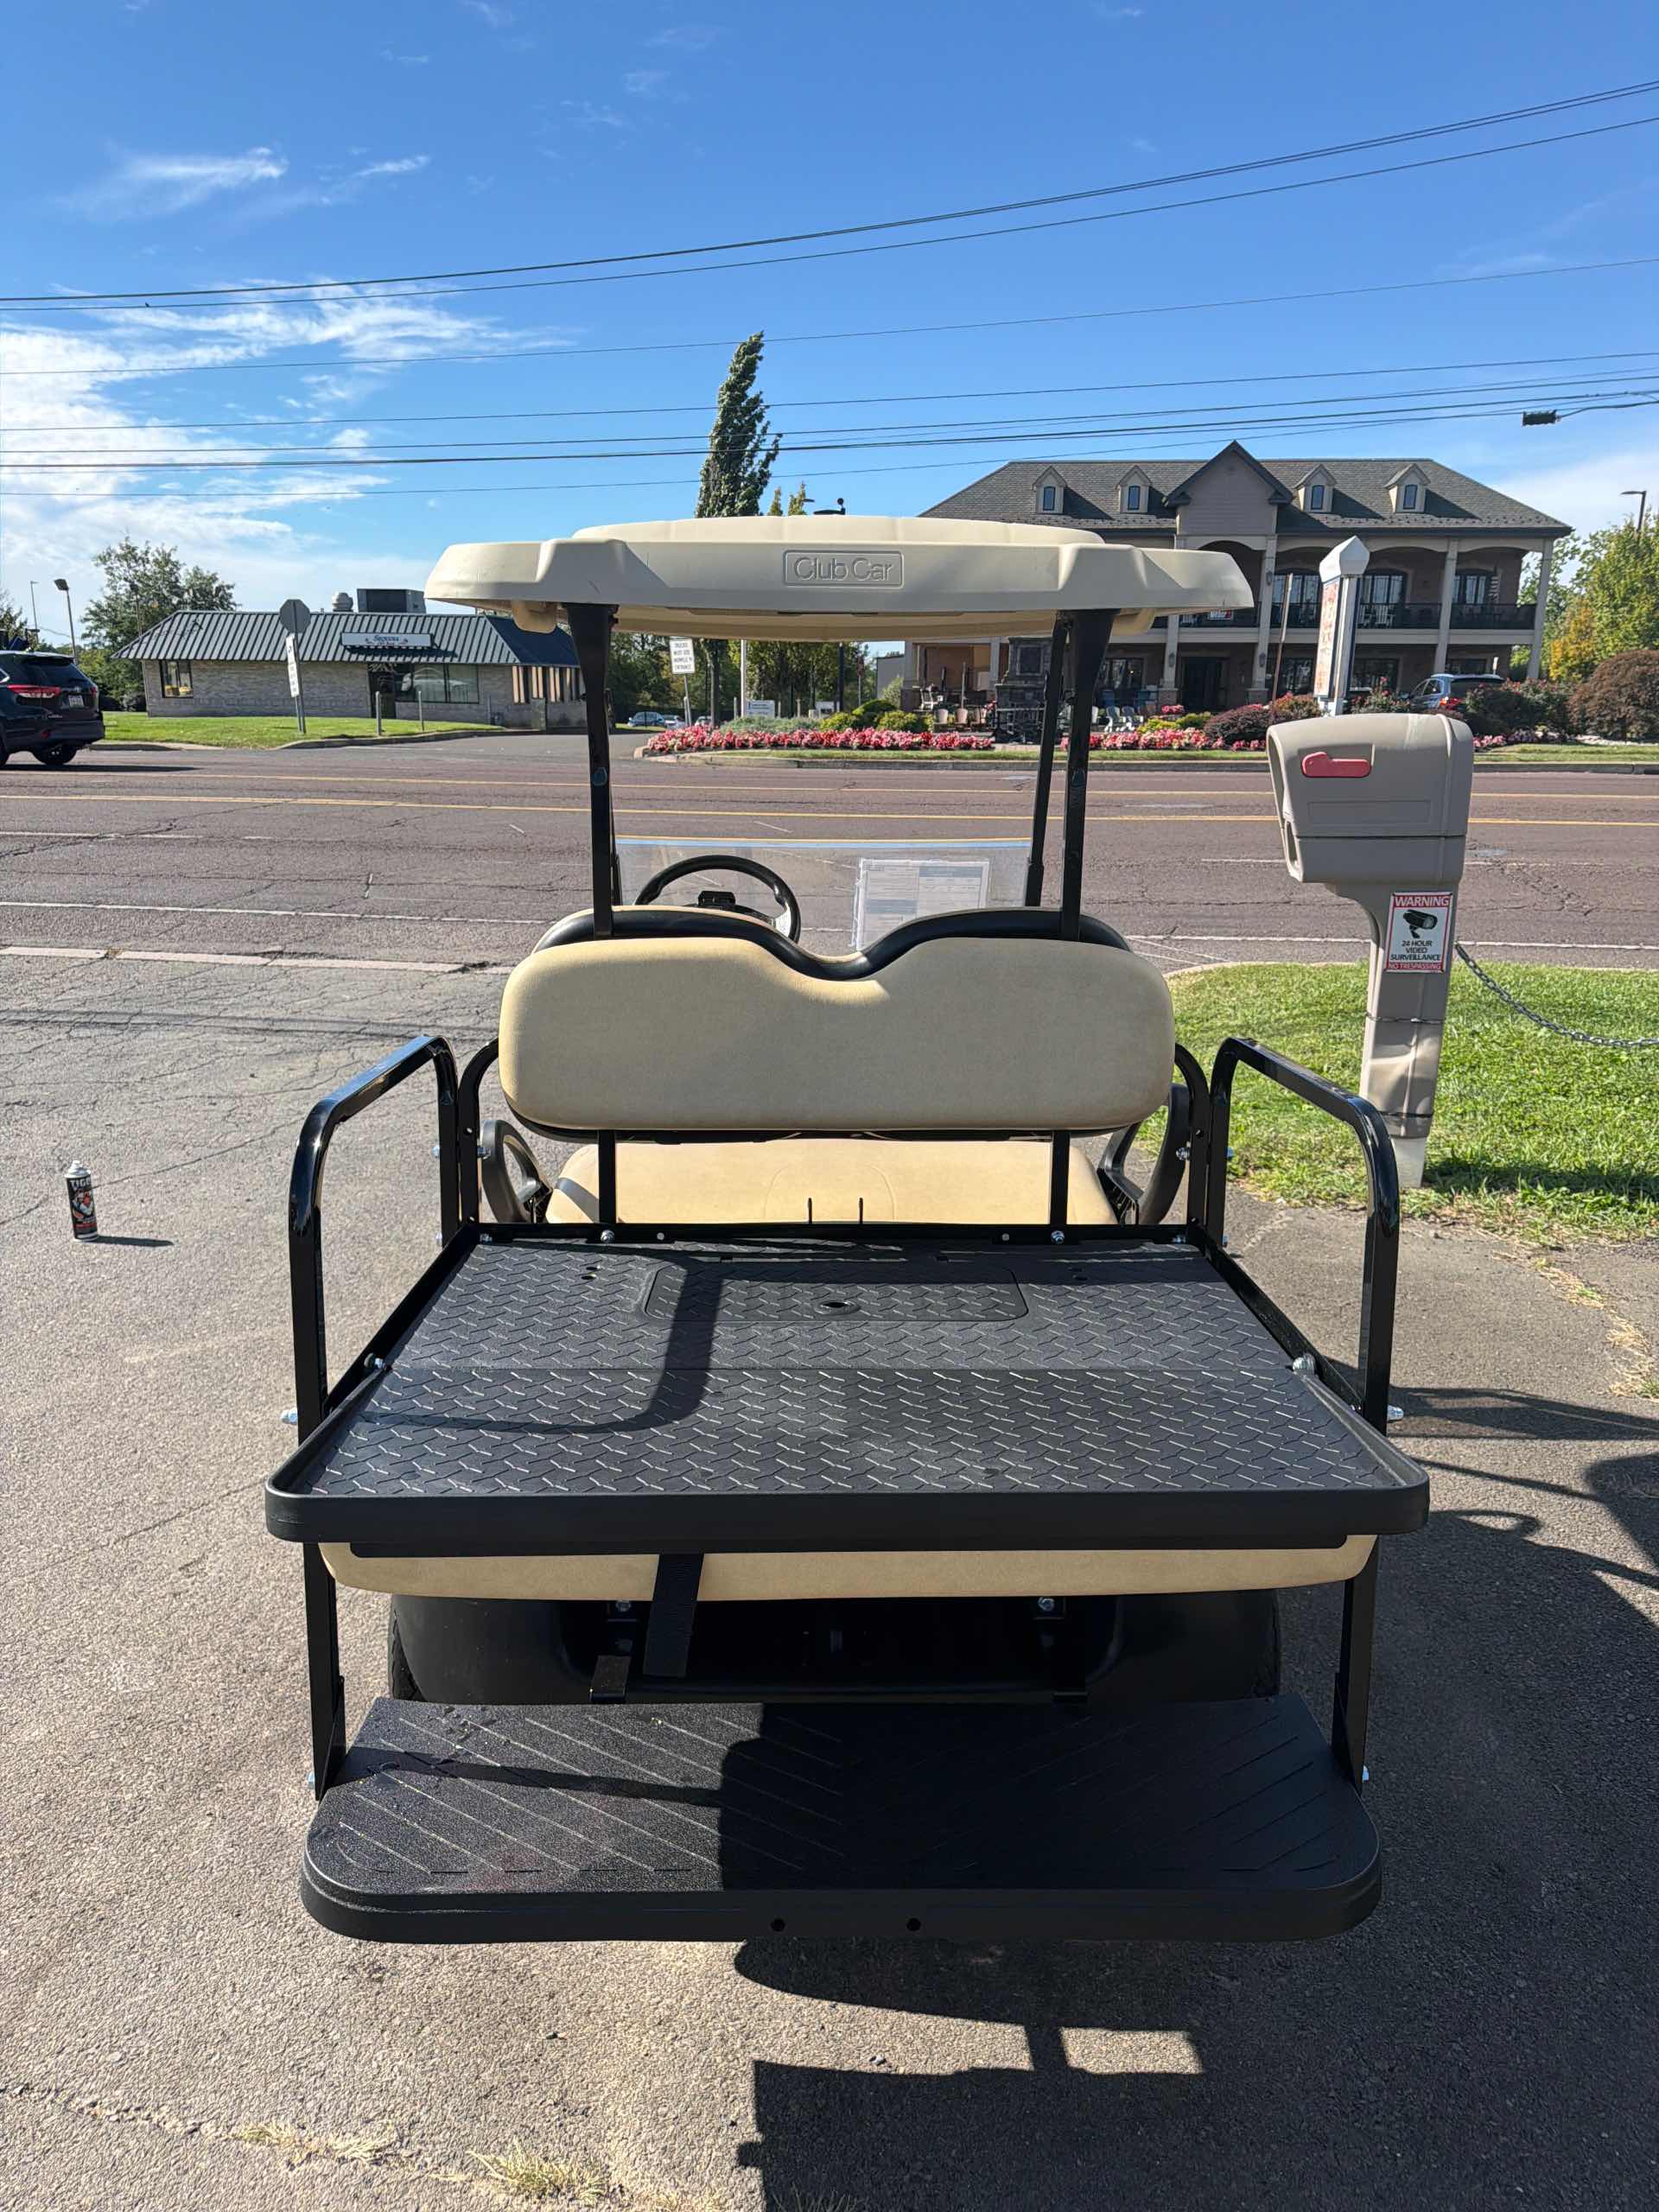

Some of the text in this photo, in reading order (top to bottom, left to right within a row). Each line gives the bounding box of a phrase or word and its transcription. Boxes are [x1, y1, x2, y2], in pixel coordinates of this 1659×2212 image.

[794, 556, 894, 582] Club Car
[1394, 895, 1450, 907] WARNING
